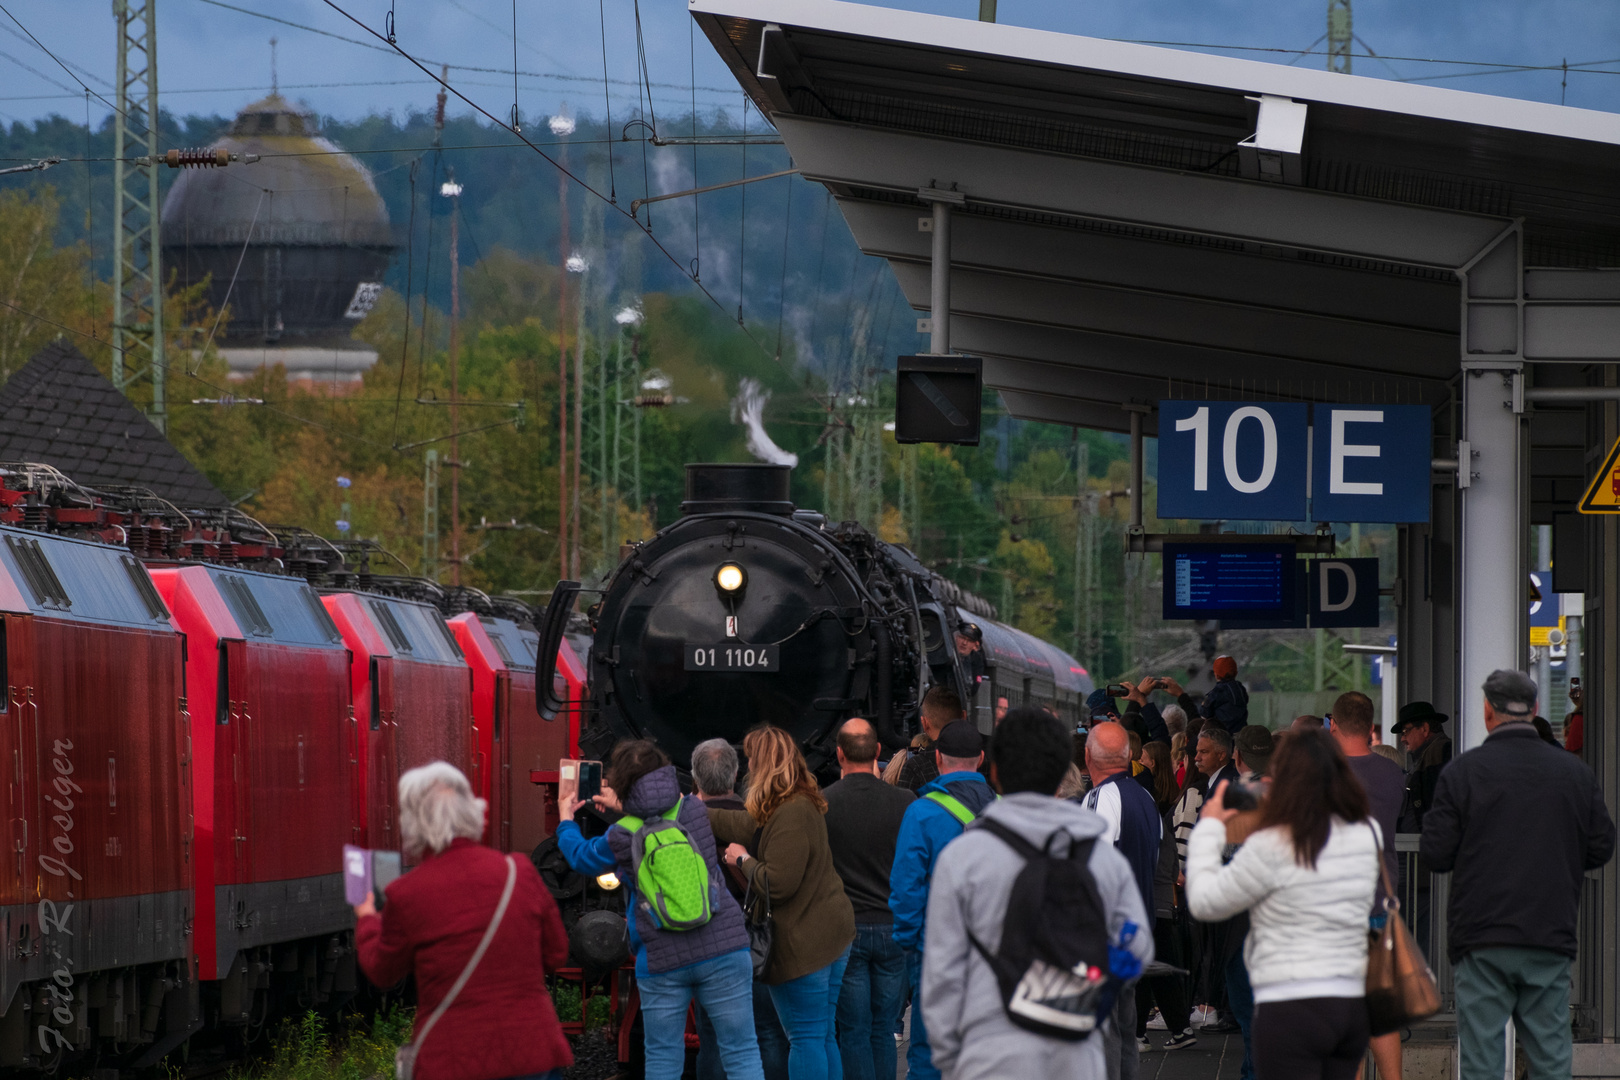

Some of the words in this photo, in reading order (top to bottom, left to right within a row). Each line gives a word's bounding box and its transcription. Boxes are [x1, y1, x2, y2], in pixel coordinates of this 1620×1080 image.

[1175, 406, 1278, 494] 10
[1329, 409, 1384, 495] E
[1320, 562, 1357, 612] D
[694, 648, 715, 667] 01
[725, 648, 769, 667] 1104
